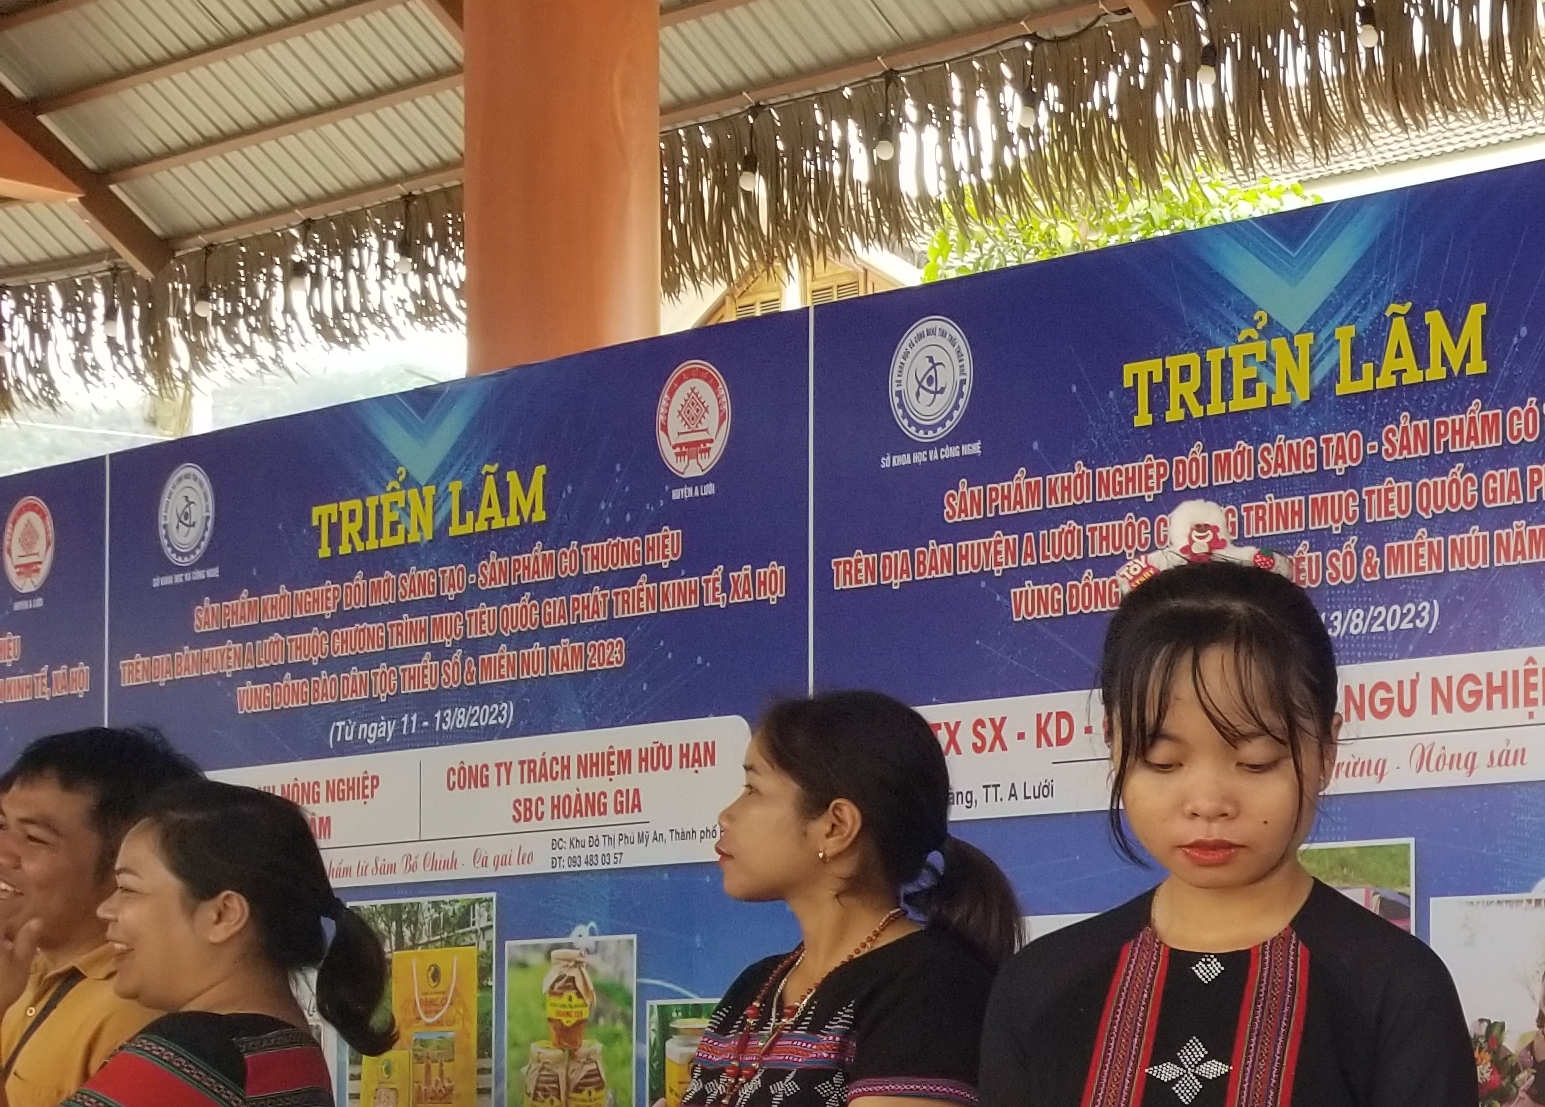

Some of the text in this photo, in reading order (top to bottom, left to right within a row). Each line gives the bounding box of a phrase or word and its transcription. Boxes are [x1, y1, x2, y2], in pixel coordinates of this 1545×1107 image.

[1123, 302, 1488, 428] TRIỂN LÃM
[892, 454, 911, 467] KHOA
[913, 452, 927, 466] HỌC
[929, 447, 939, 461] VÀ
[940, 445, 960, 460] CÔNG
[312, 462, 546, 559] TRIỂN LÃM
[1119, 554, 1149, 582] TOY
[972, 716, 1008, 754] SX
[1036, 710, 1075, 749] KD
[1344, 672, 1419, 724] NGƯ
[446, 741, 716, 792] CÔNG TY TRÁCH NHIỆM HỮU HẠN
[1410, 739, 1528, 778] Nông sản
[281, 771, 379, 807] NÔNG NGHIỆP
[512, 788, 642, 823] SBC HOÀNG GIA
[983, 779, 1054, 805] TT. A Lưới
[551, 838, 567, 850] ĐC:
[569, 837, 585, 848] Khu
[603, 832, 616, 848] Thị
[618, 831, 635, 845] Phú
[638, 830, 649, 847] Mỹ
[652, 831, 667, 844] An,
[669, 828, 697, 841] Thành
[700, 824, 717, 842] phố
[551, 852, 623, 868] ĐT: 093 483 03 57
